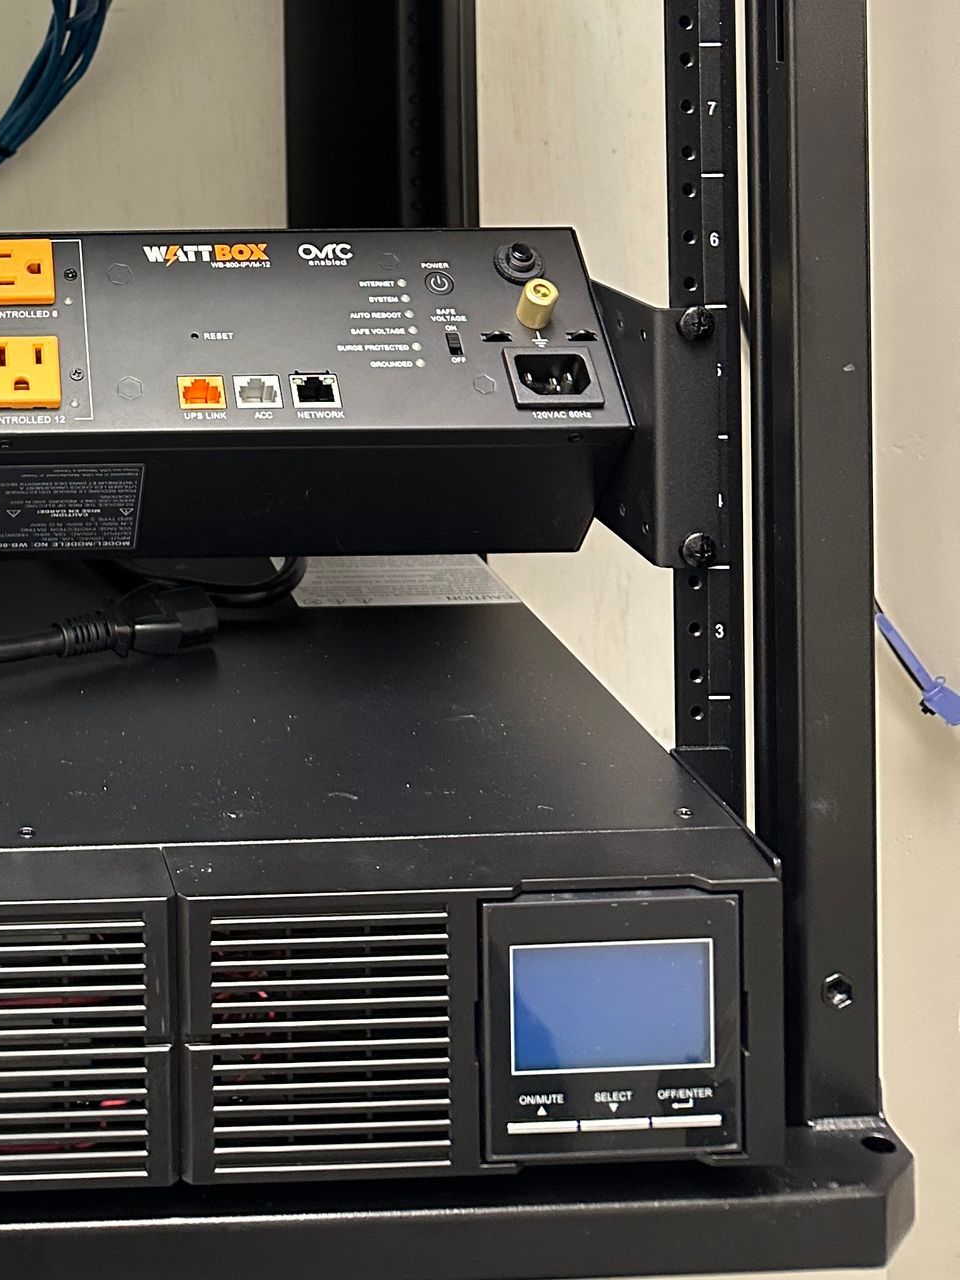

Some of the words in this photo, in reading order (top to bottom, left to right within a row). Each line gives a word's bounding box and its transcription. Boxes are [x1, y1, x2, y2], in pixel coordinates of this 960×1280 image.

[708, 102, 716, 115] 7
[710, 232, 719, 246] 6
[716, 624, 724, 638] 3
[595, 1091, 632, 1102] SELECT
[657, 1087, 712, 1099] OFF/ENTER
[519, 1094, 564, 1105] ON/MUTE
